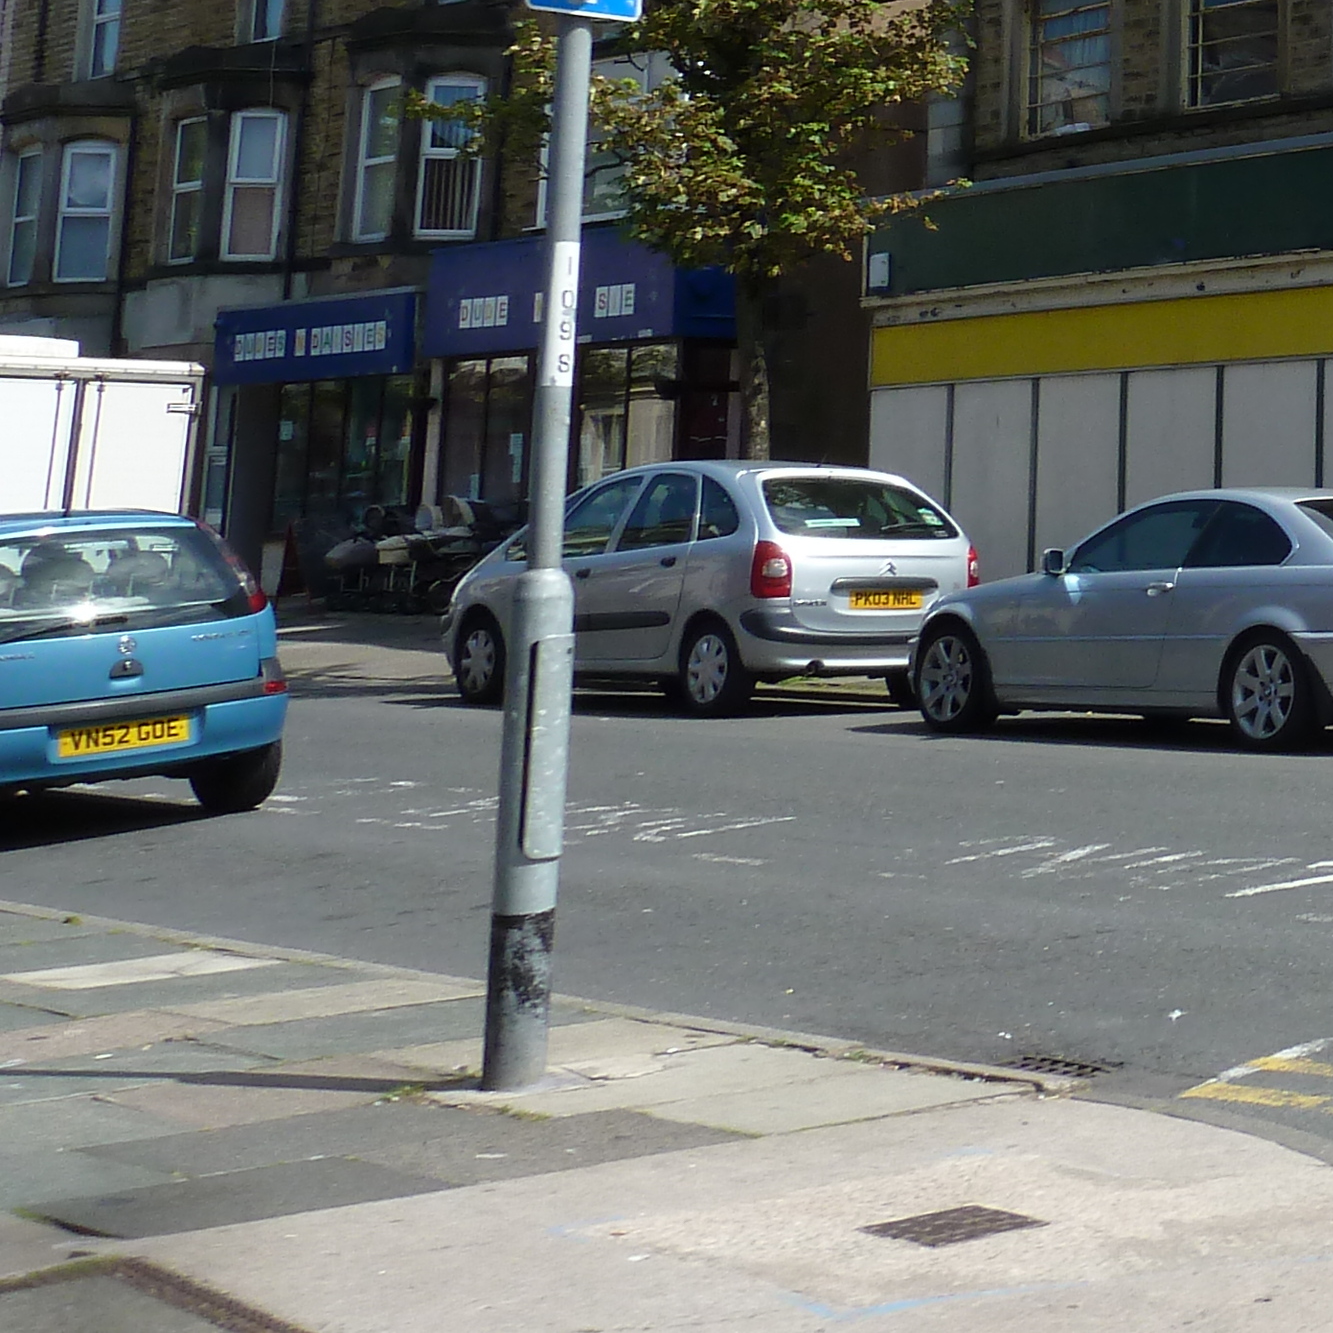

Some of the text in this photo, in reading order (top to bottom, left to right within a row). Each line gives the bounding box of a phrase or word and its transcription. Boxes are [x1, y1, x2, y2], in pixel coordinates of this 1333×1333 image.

[855, 591, 916, 606] PK03 NHL
[69, 724, 131, 751] VN52
